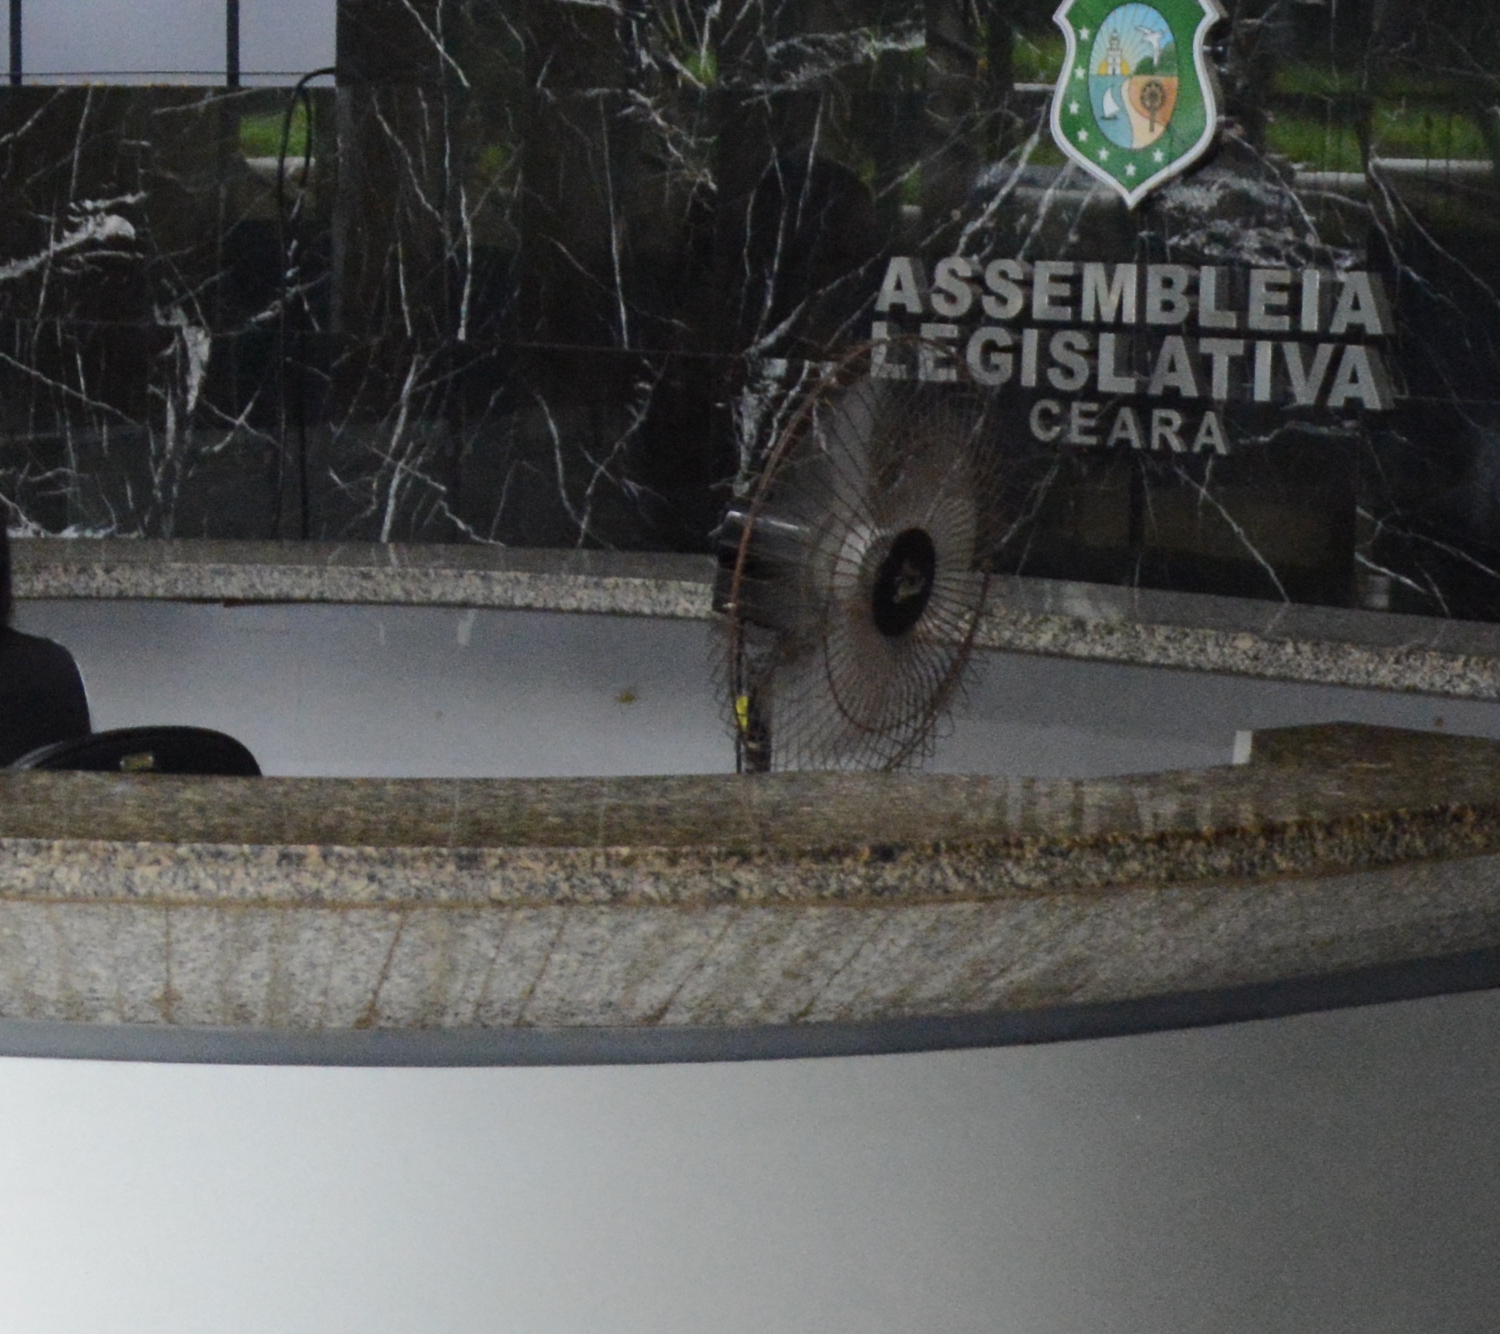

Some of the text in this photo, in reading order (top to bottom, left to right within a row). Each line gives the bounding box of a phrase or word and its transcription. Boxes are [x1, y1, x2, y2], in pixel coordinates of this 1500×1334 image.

[874, 255, 1386, 336] ASSEMBLEIA
[870, 320, 1385, 411] LEGISLATIVA
[1028, 398, 1230, 455] CEARA
